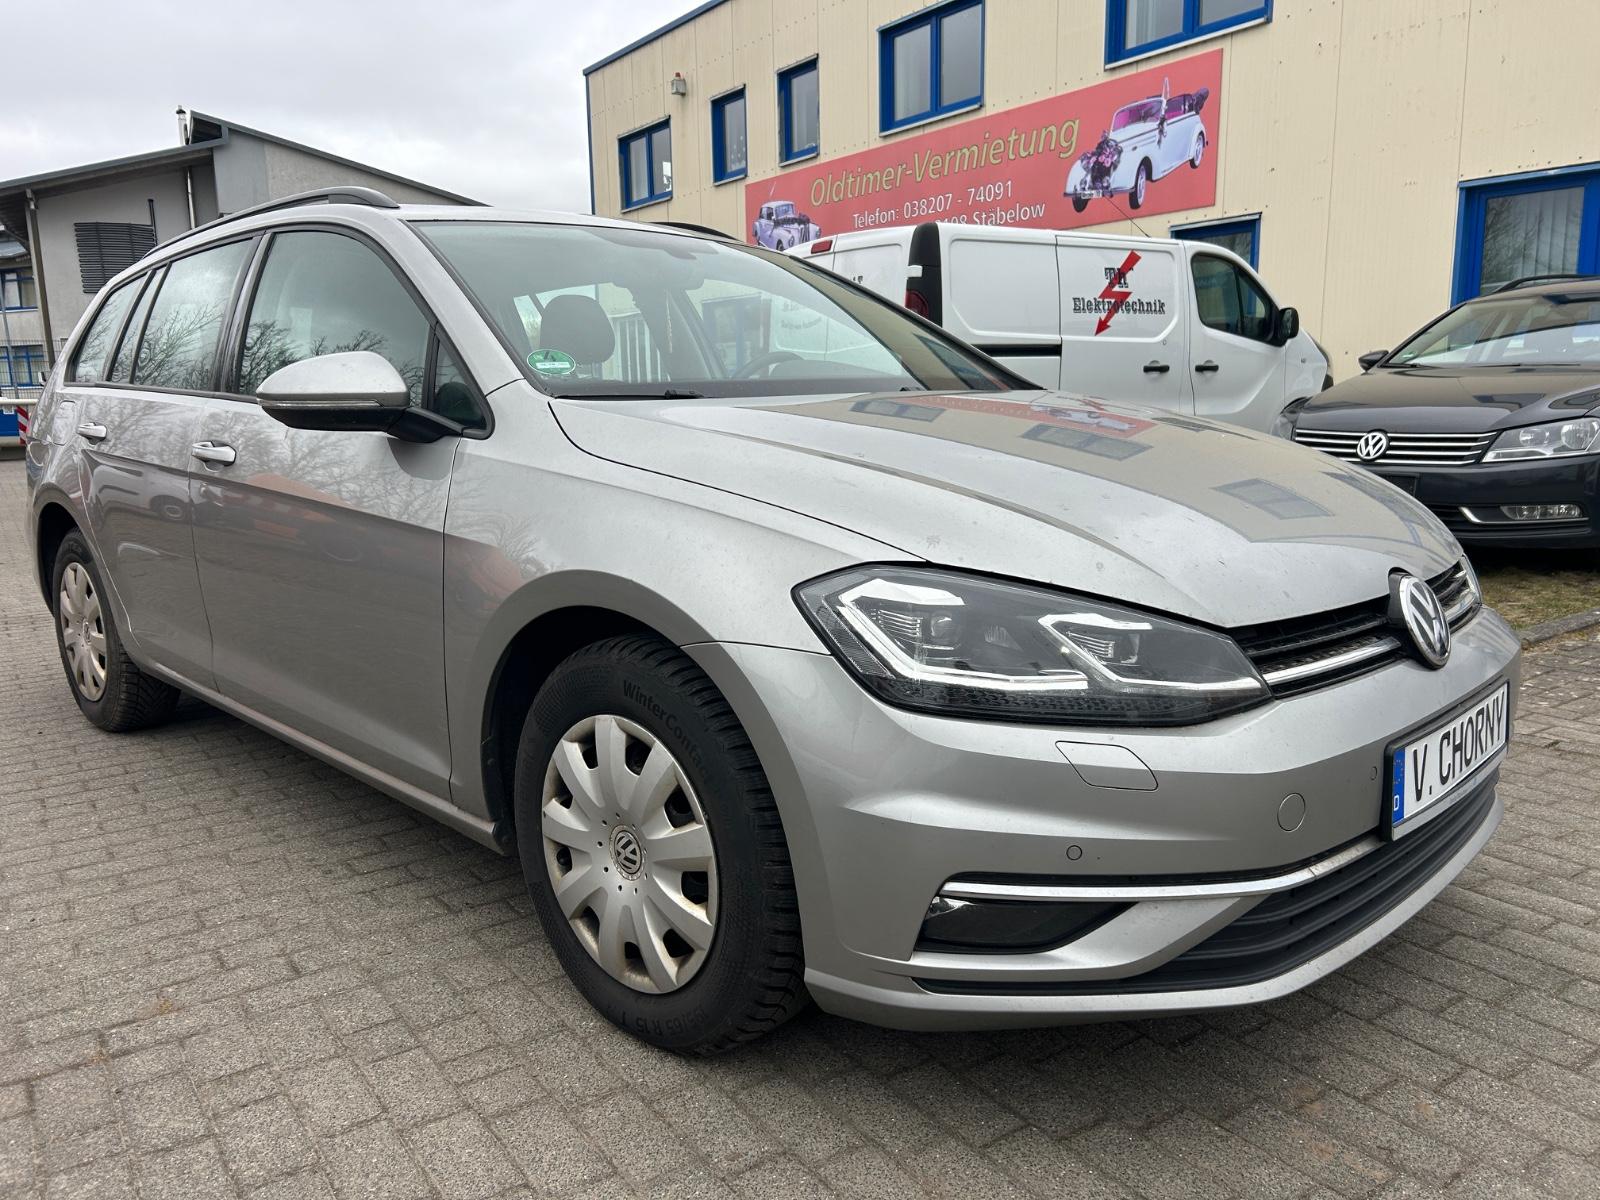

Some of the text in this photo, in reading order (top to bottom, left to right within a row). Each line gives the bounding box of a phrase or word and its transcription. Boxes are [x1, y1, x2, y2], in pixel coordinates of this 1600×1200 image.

[811, 119, 1080, 207] Oldtimer-Vermietung
[853, 207, 900, 229] Telefon:
[903, 193, 953, 219] 038207
[967, 180, 1013, 206] 74091
[973, 203, 1045, 226] Stäbelow
[1072, 297, 1166, 314] Elektrotechnik
[1413, 690, 1505, 802] V. CHORNY
[1393, 795, 1400, 811] D
